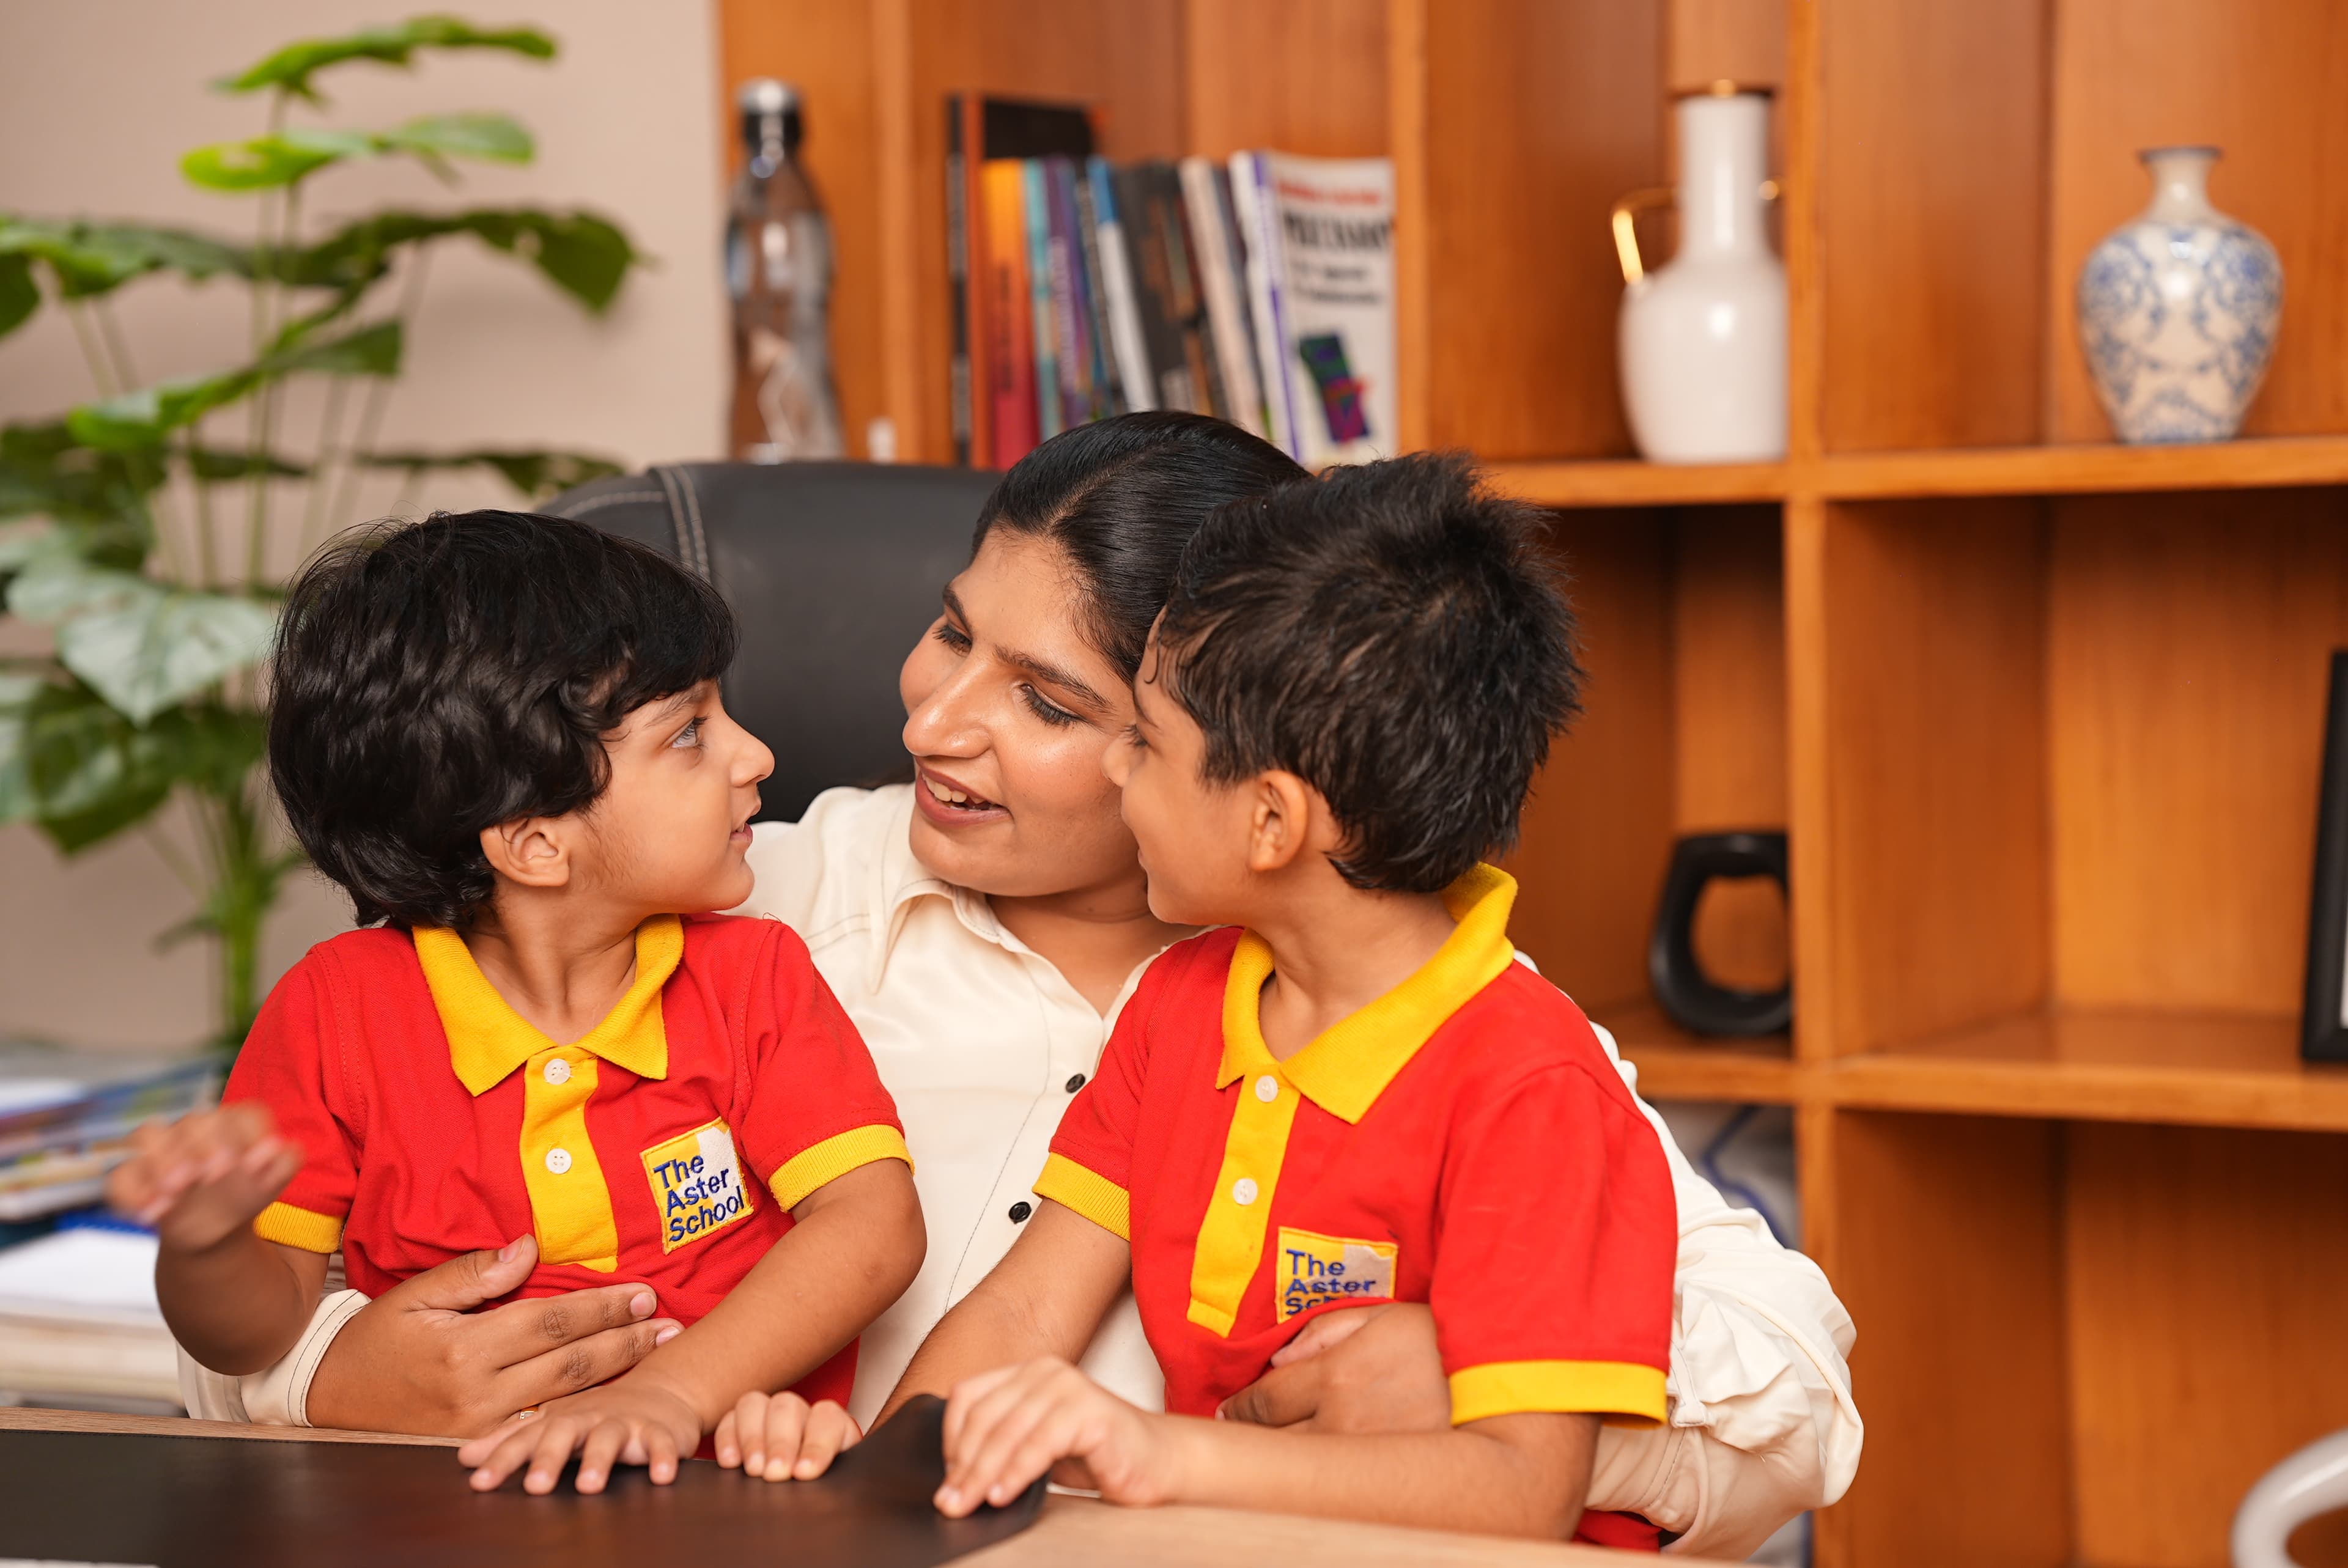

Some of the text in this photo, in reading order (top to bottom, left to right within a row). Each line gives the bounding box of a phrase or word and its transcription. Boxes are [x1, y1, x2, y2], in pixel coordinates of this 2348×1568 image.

[654, 1155, 704, 1189] The
[667, 1168, 729, 1217] Aster
[669, 1185, 744, 1242] School
[1286, 1248, 1345, 1276] The
[1285, 1278, 1376, 1296] Aster
